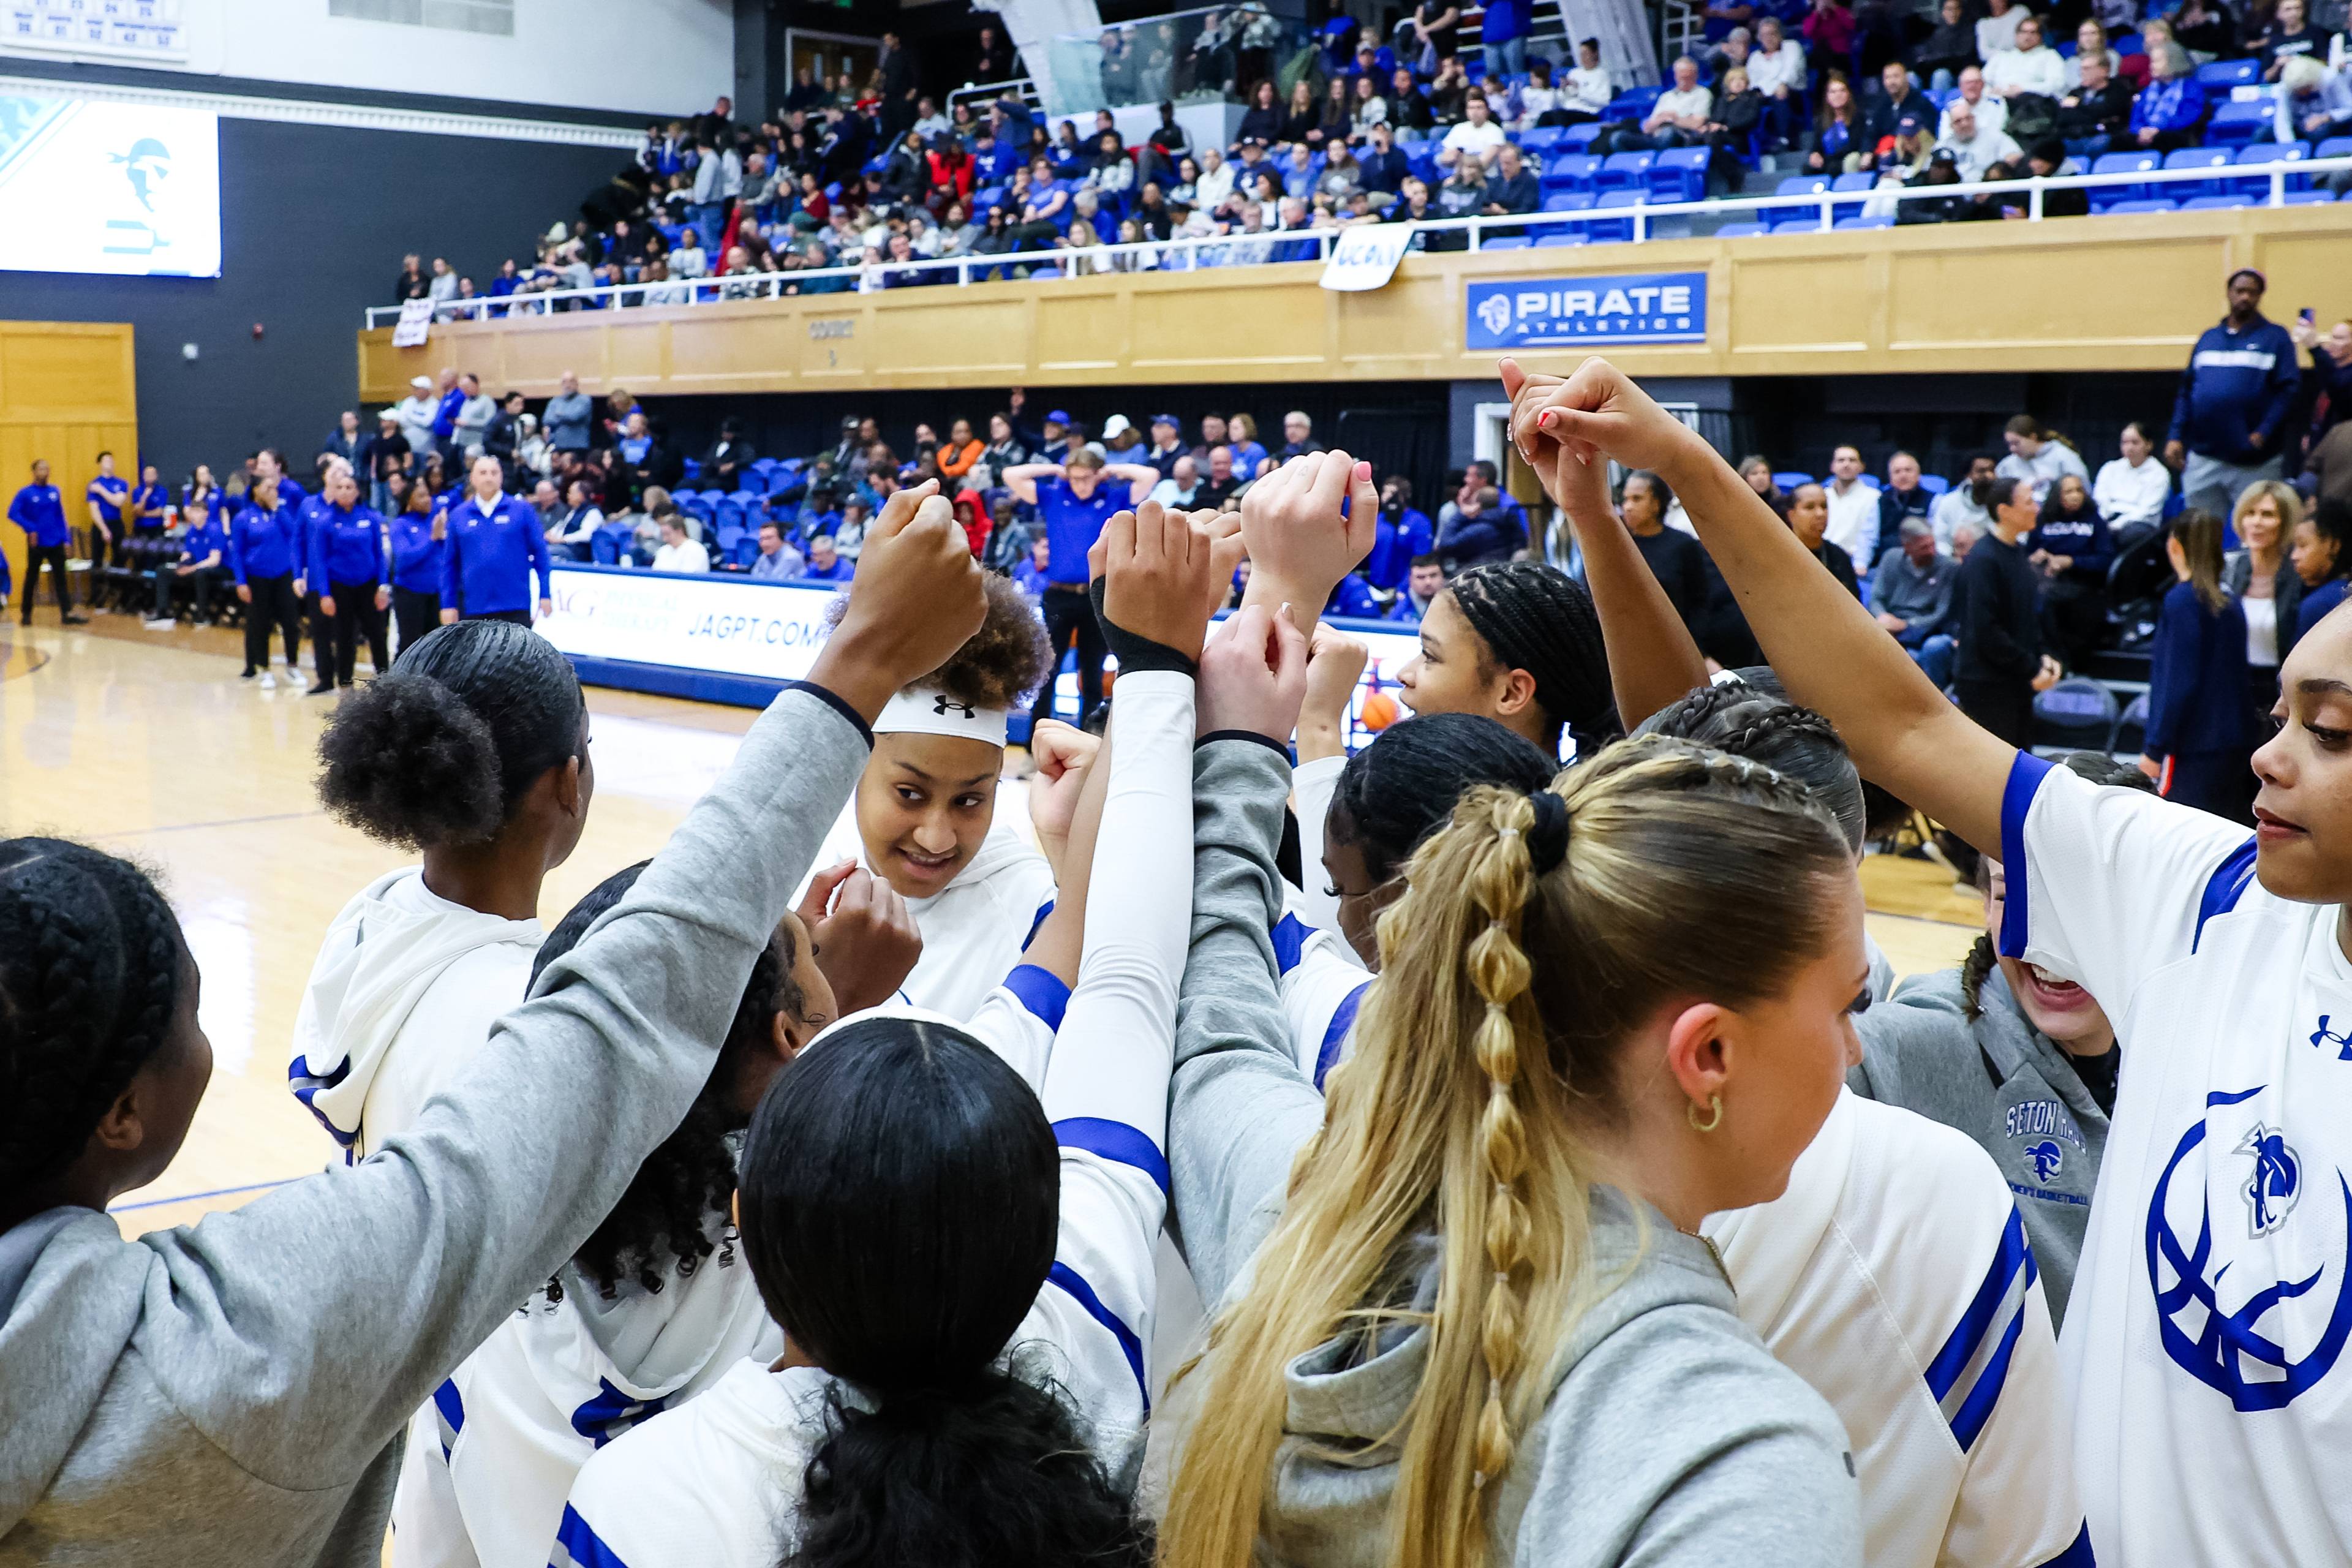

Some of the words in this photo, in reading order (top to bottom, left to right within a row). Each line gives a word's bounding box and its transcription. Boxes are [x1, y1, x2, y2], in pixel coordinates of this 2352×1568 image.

[1515, 285, 1691, 319] PIRATE
[1515, 317, 1691, 334] ATHLETICS
[688, 612, 820, 647] JAGPT.COM
[2005, 1099, 2059, 1139] SETON
